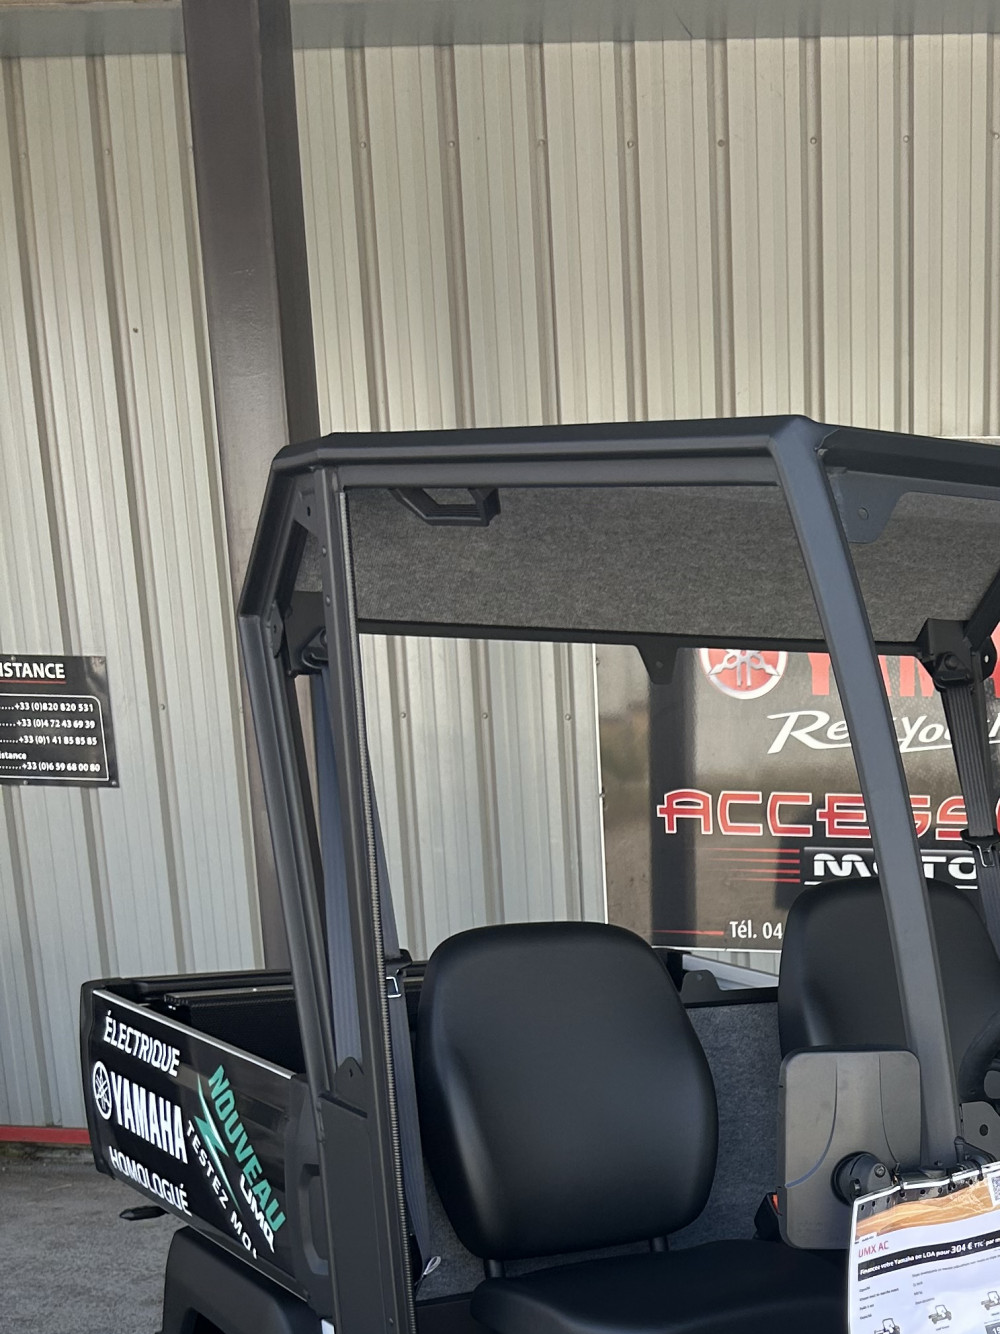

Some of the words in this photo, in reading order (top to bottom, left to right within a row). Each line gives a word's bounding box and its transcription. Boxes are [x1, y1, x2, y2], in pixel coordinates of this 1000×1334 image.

[50, 720, 61, 728] 72
[61, 720, 72, 728] 43
[84, 720, 96, 729] 39
[78, 703, 94, 712] 531
[52, 736, 62, 744] 41
[767, 710, 851, 754] Re
[729, 919, 758, 940] Tél.
[762, 921, 783, 940] 04
[103, 1009, 180, 1078] ÉLECTRIQUE
[110, 1070, 188, 1165] YAMAHA
[185, 1119, 229, 1210] TESTEZ
[208, 1065, 286, 1232] NOUVEAU
[108, 1145, 192, 1217] HOMOLOGUÉ
[858, 1244, 877, 1258] UMX
[878, 1240, 889, 1251] AC
[894, 1254, 915, 1265] Yamaha
[922, 1250, 935, 1259] LOA
[951, 1243, 966, 1255] 304
[967, 1241, 973, 1250] €
